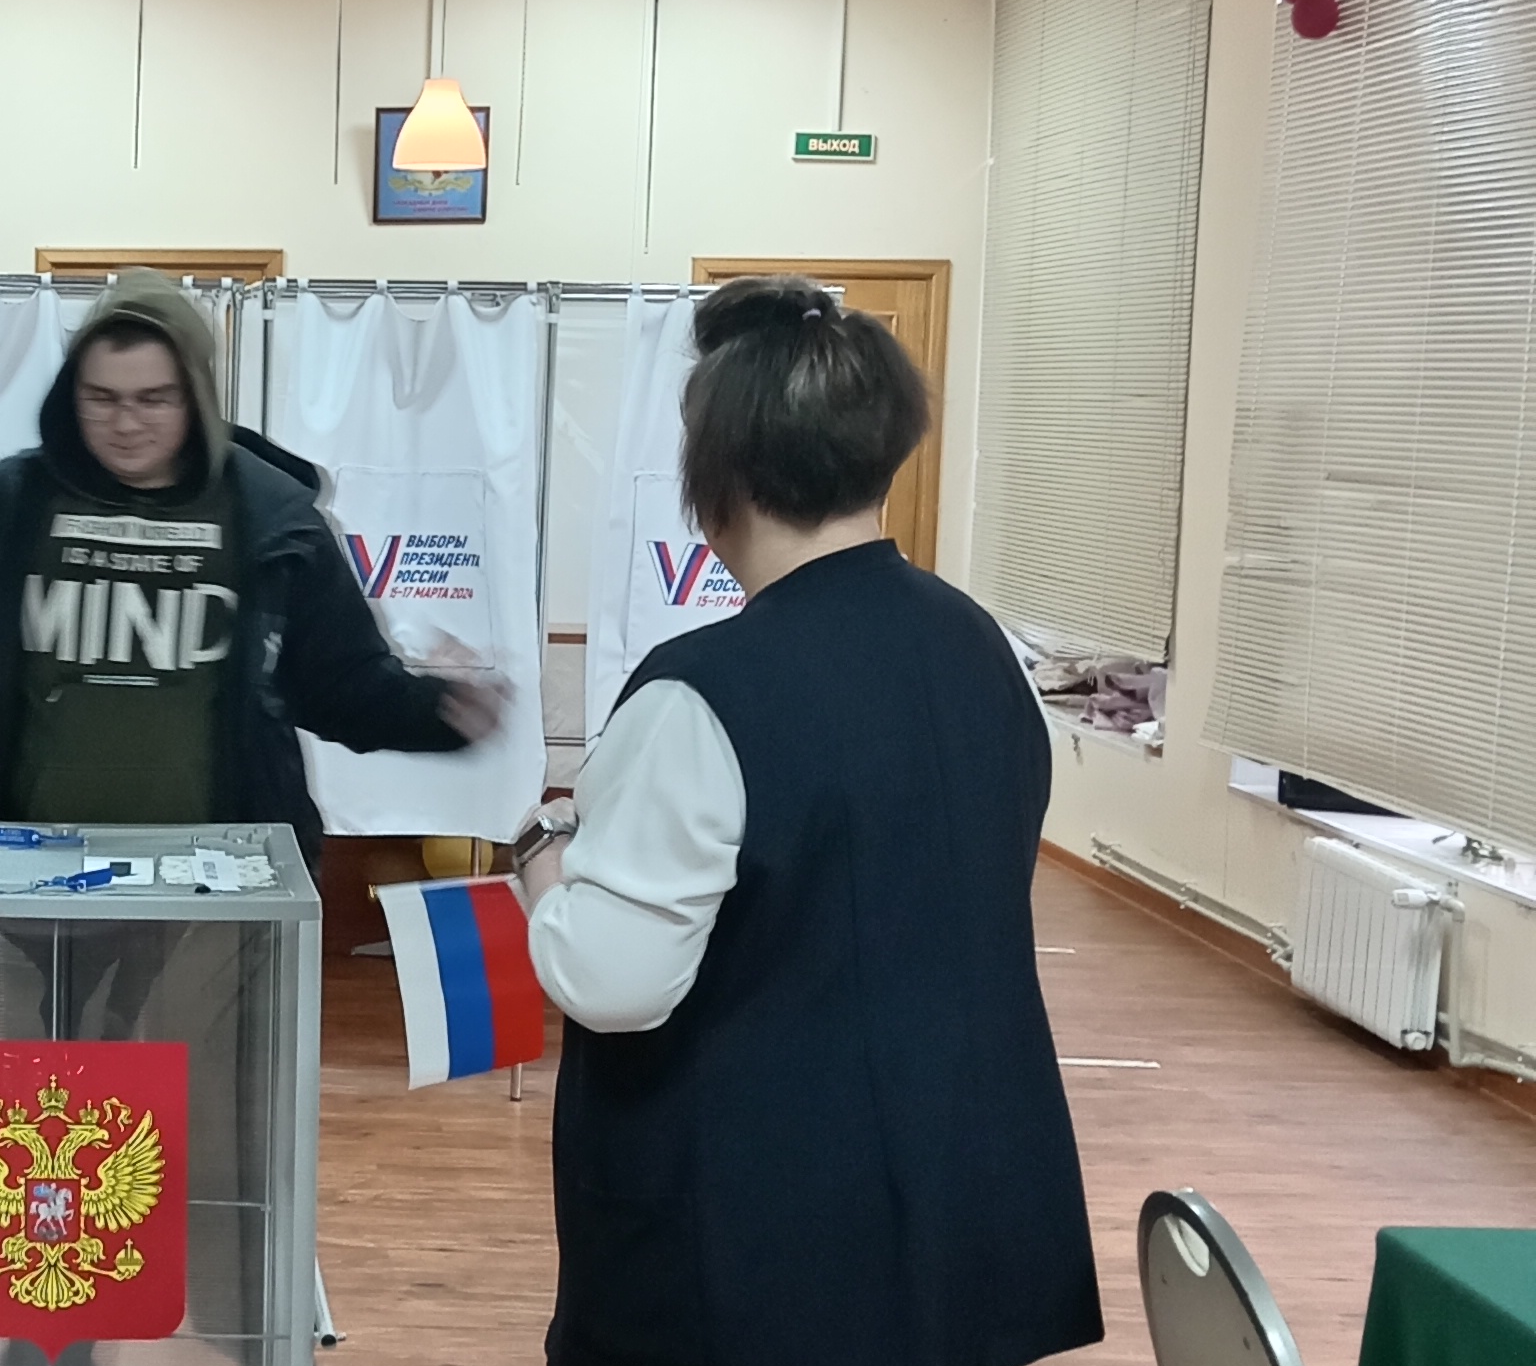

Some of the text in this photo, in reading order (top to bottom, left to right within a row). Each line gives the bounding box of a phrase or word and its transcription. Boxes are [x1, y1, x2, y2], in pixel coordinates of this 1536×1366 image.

[808, 138, 860, 154] ВЫХОД
[406, 534, 468, 549] ВЫБОРЫ
[394, 570, 449, 584] РОССИИ
[414, 587, 450, 600] МАРТА
[449, 588, 474, 600] 2024
[21, 573, 239, 671] MIND
